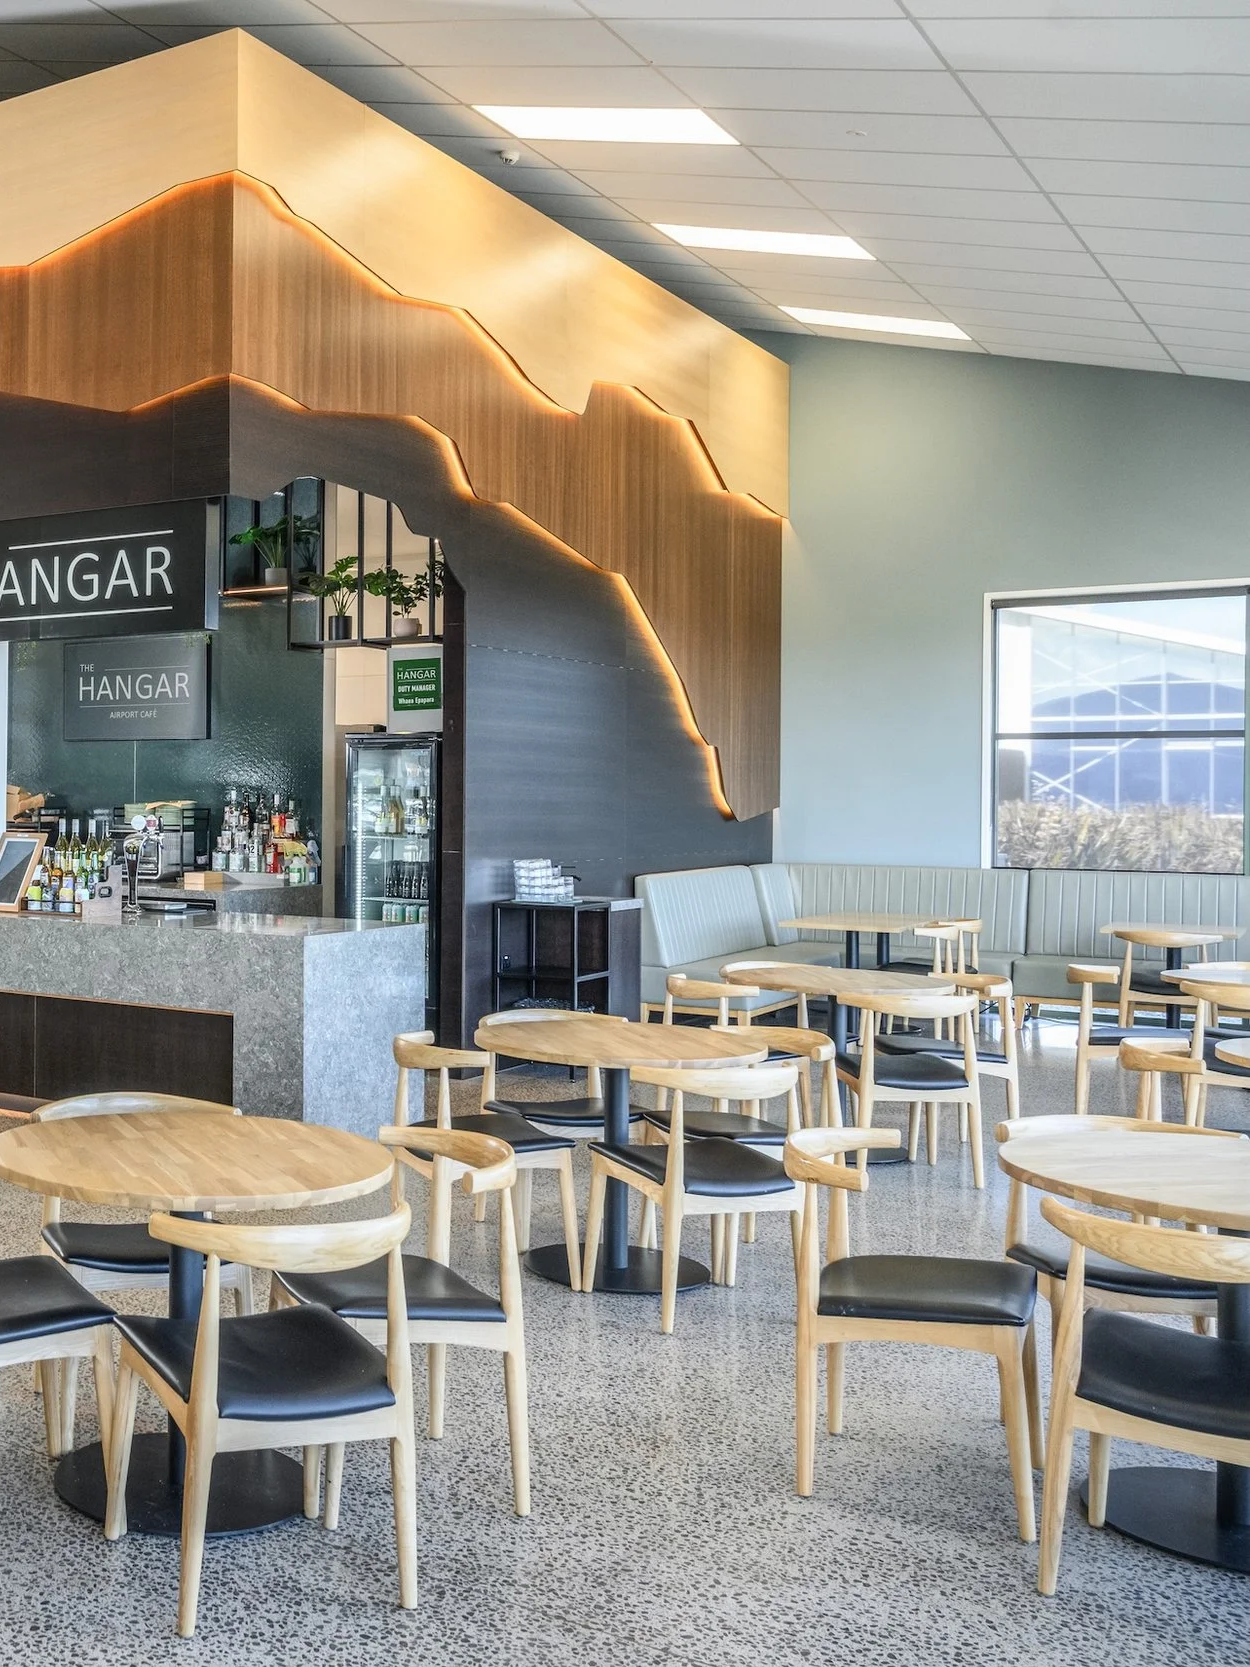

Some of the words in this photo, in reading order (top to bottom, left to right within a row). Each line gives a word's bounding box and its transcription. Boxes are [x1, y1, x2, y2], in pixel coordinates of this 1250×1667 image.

[79, 664, 94, 672] THE
[397, 670, 436, 679] HANGAR
[79, 672, 190, 701] HANGAR
[109, 711, 138, 719] AIRPORT
[140, 708, 157, 718] CAFÉ
